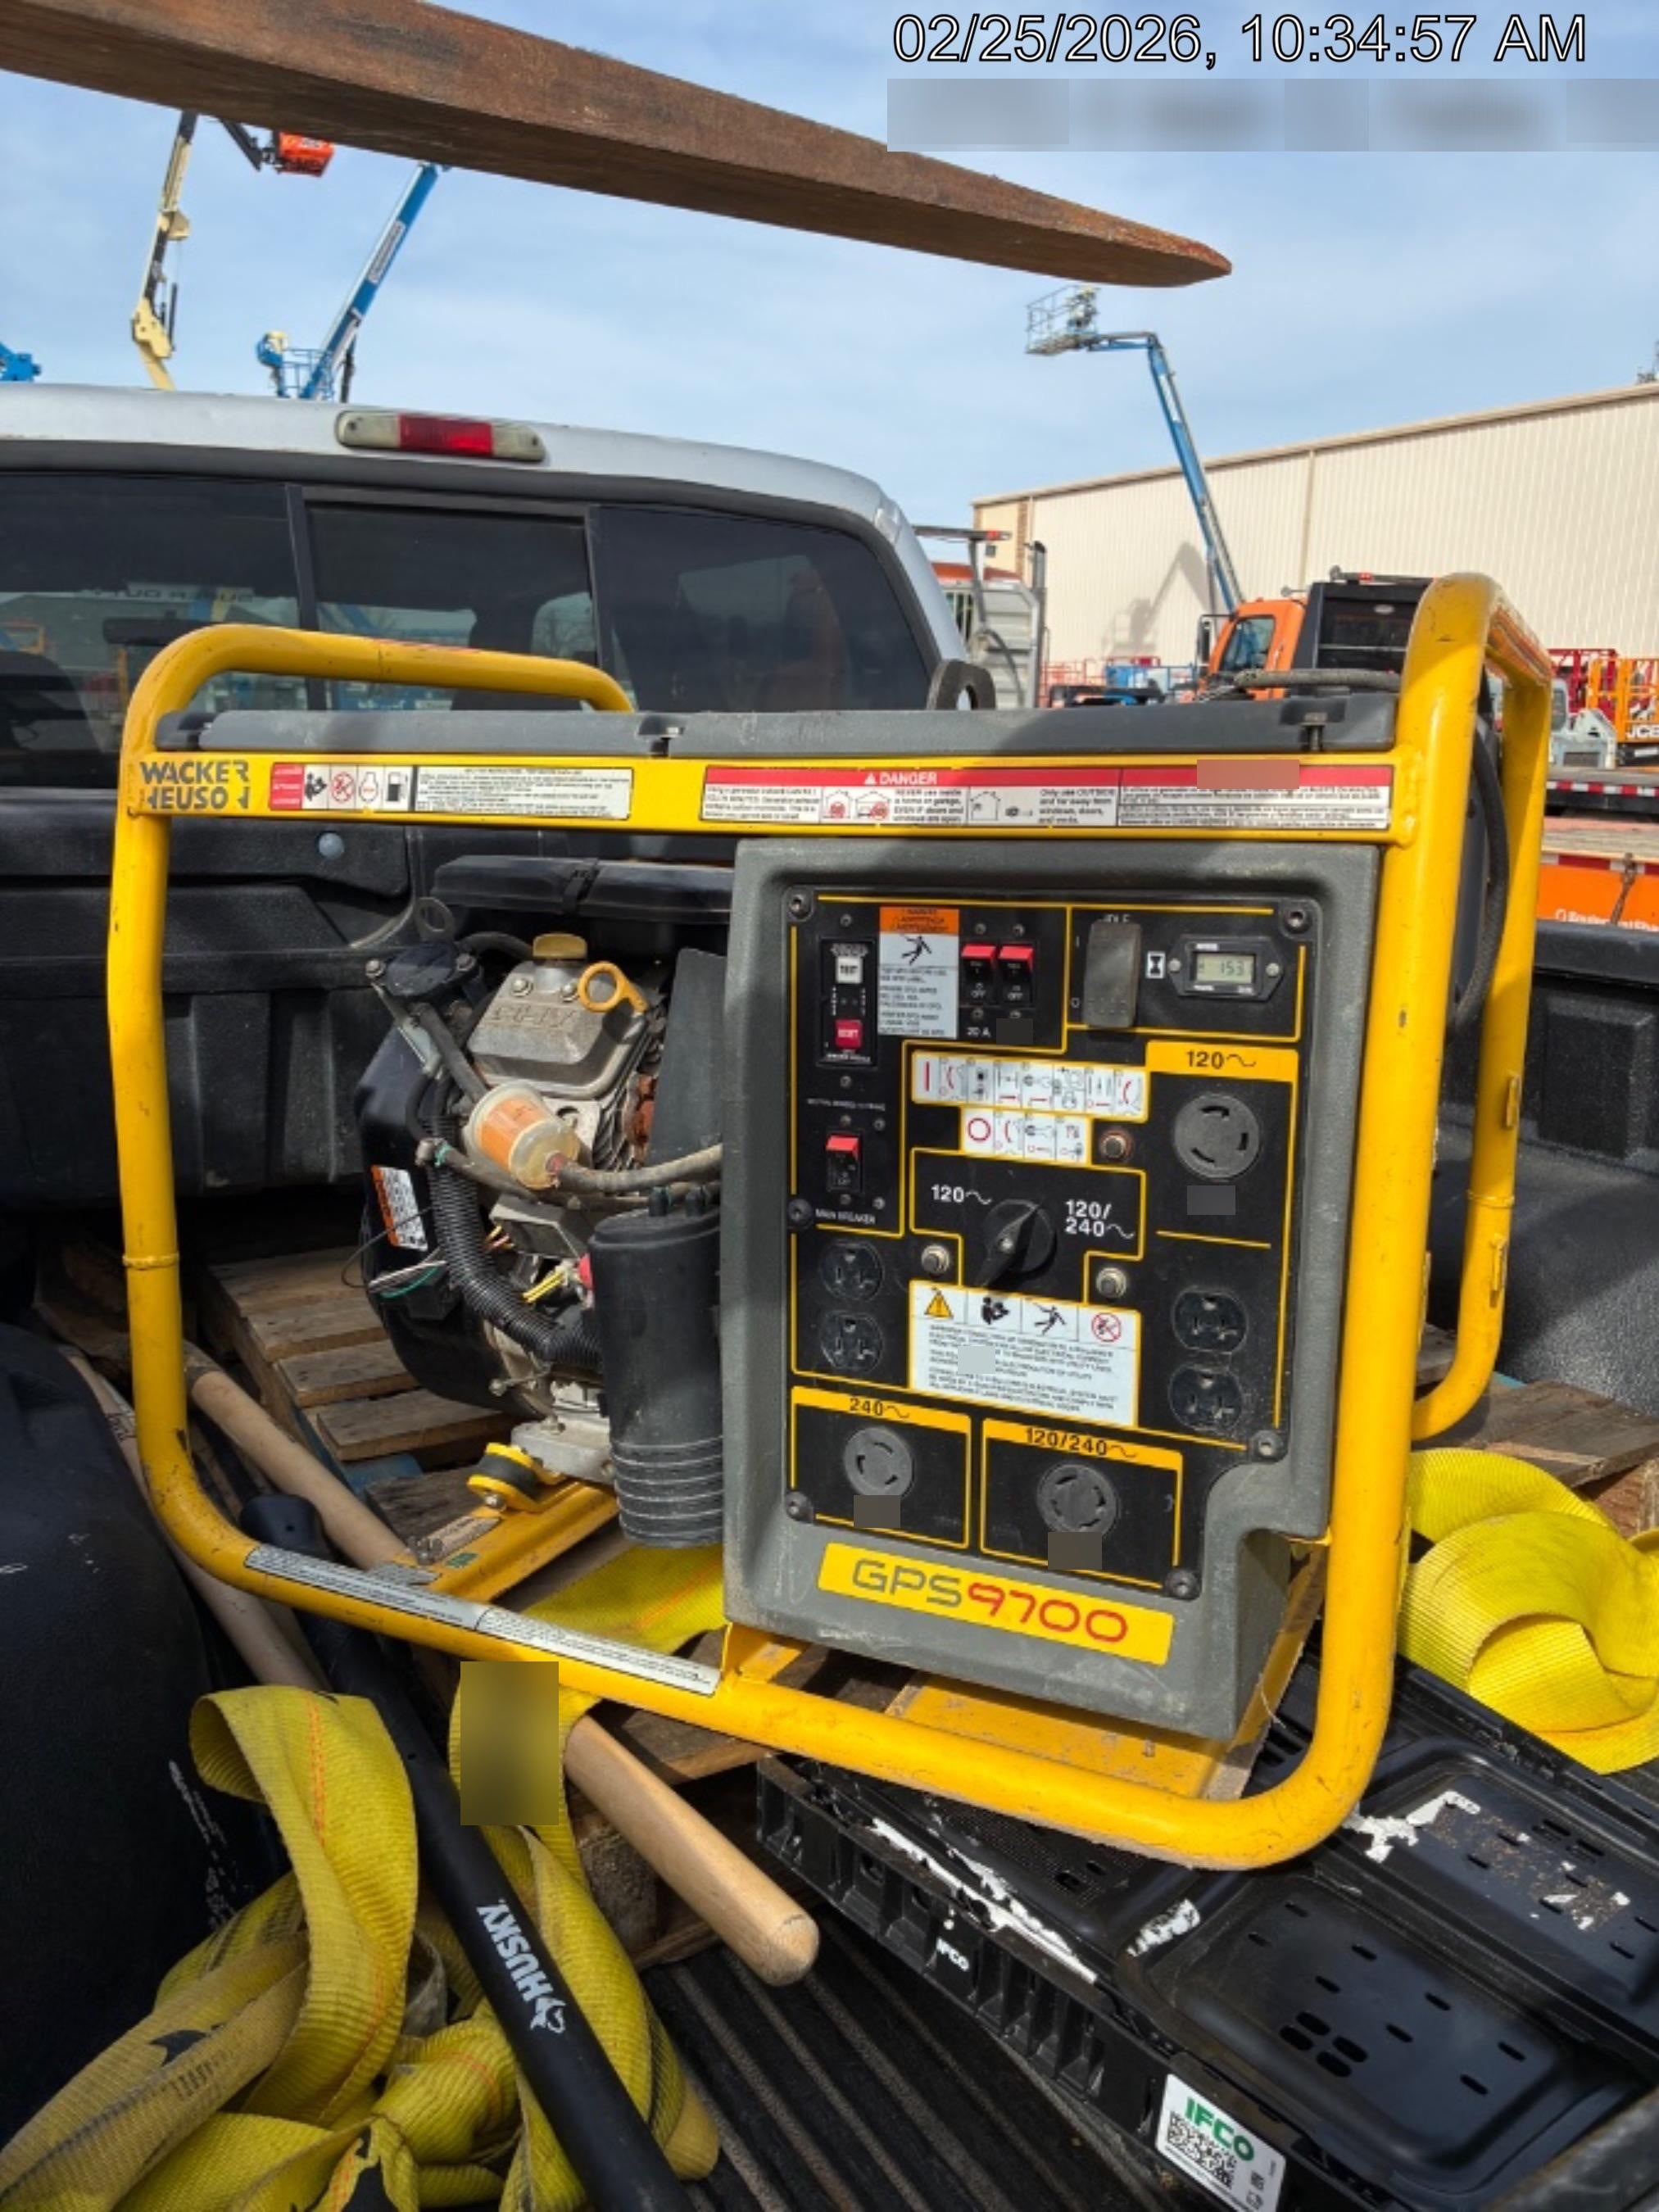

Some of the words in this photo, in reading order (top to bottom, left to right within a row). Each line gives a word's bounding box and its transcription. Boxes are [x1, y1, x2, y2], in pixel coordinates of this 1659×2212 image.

[139, 759, 250, 784] WACKER
[879, 771, 937, 785] DANGER
[1065, 1199, 1112, 1220] 120/
[853, 1558, 1128, 1644] GPS9700
[476, 1903, 554, 2002] HUSKY
[936, 1936, 970, 1972] IFCO
[1185, 2096, 1255, 2162] IFCO
